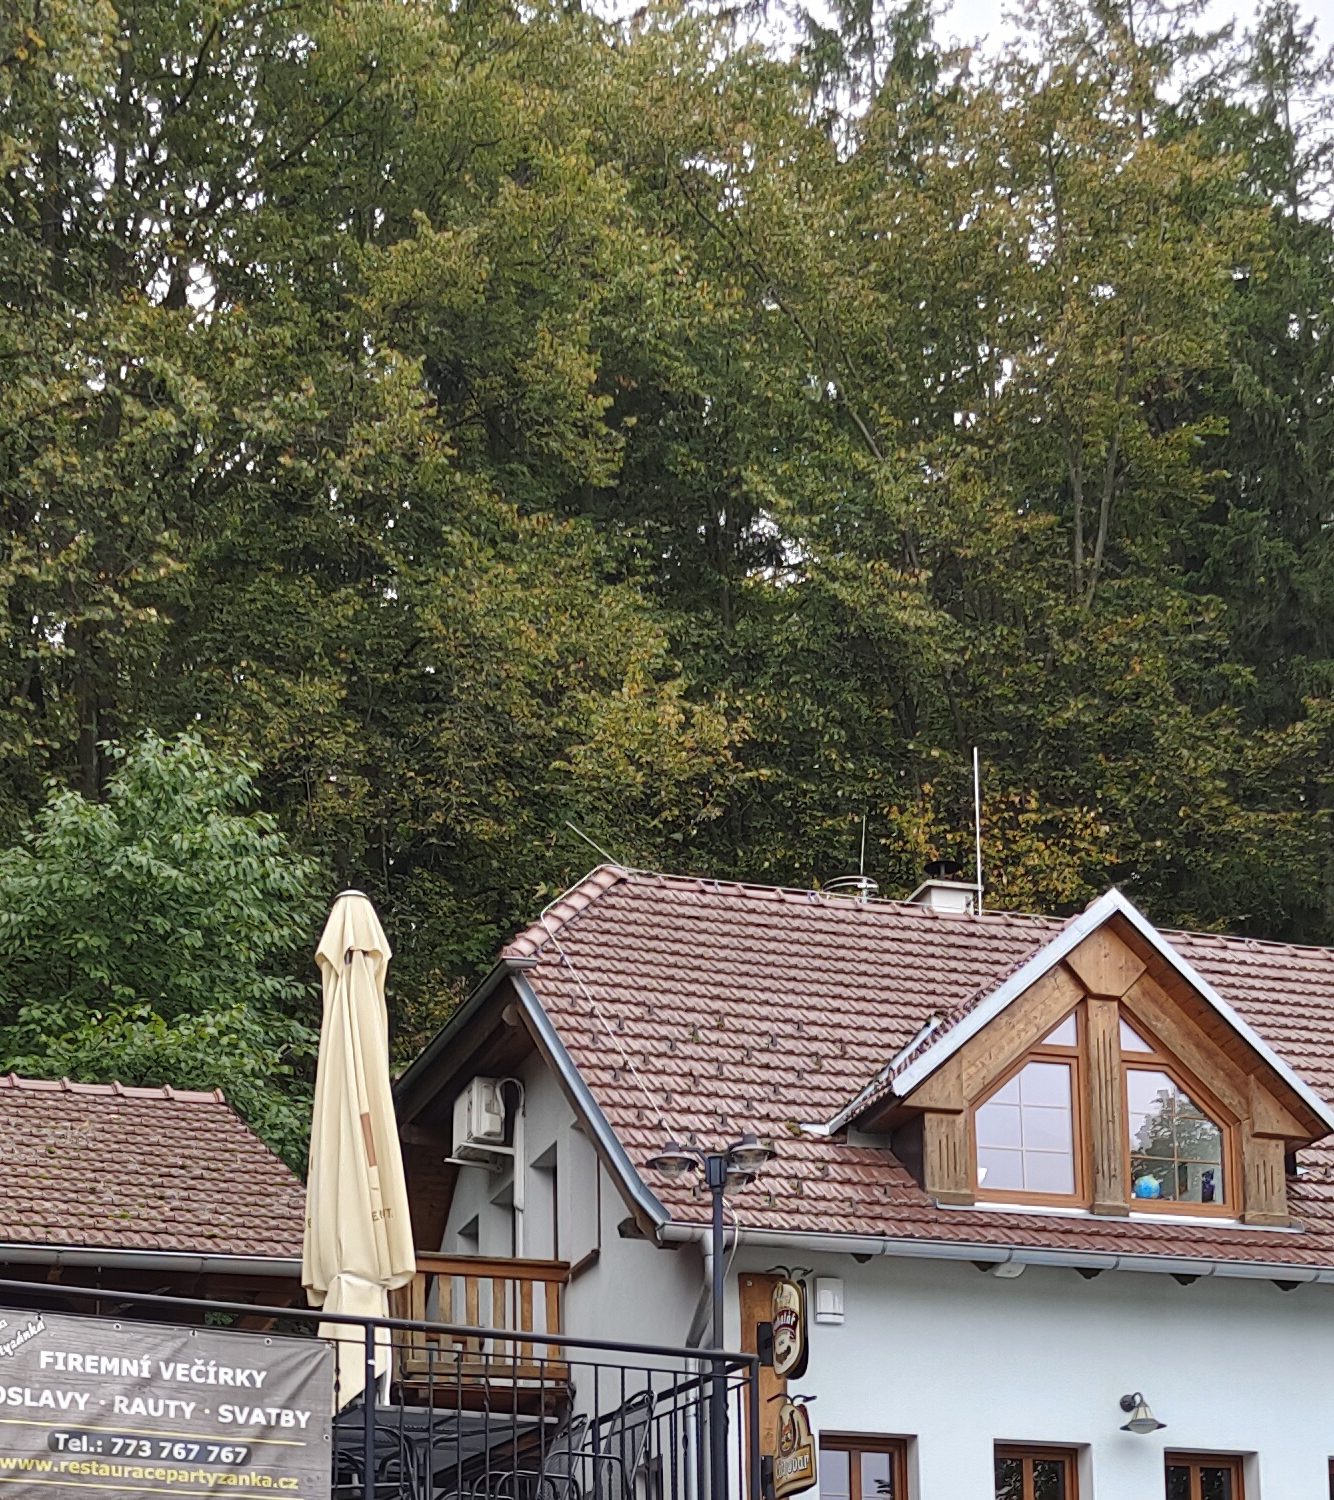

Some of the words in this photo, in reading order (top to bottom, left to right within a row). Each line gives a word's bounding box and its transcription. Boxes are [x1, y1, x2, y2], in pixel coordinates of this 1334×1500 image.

[40, 1350, 152, 1379] FIREMNÍ
[160, 1358, 267, 1389] VEČÍRKY
[113, 1397, 196, 1420] RAUTY
[218, 1406, 311, 1429] SVATBY
[55, 1433, 102, 1454] Tel.:
[111, 1437, 152, 1457] 773
[160, 1441, 199, 1461] 767
[207, 1444, 248, 1464] 767
